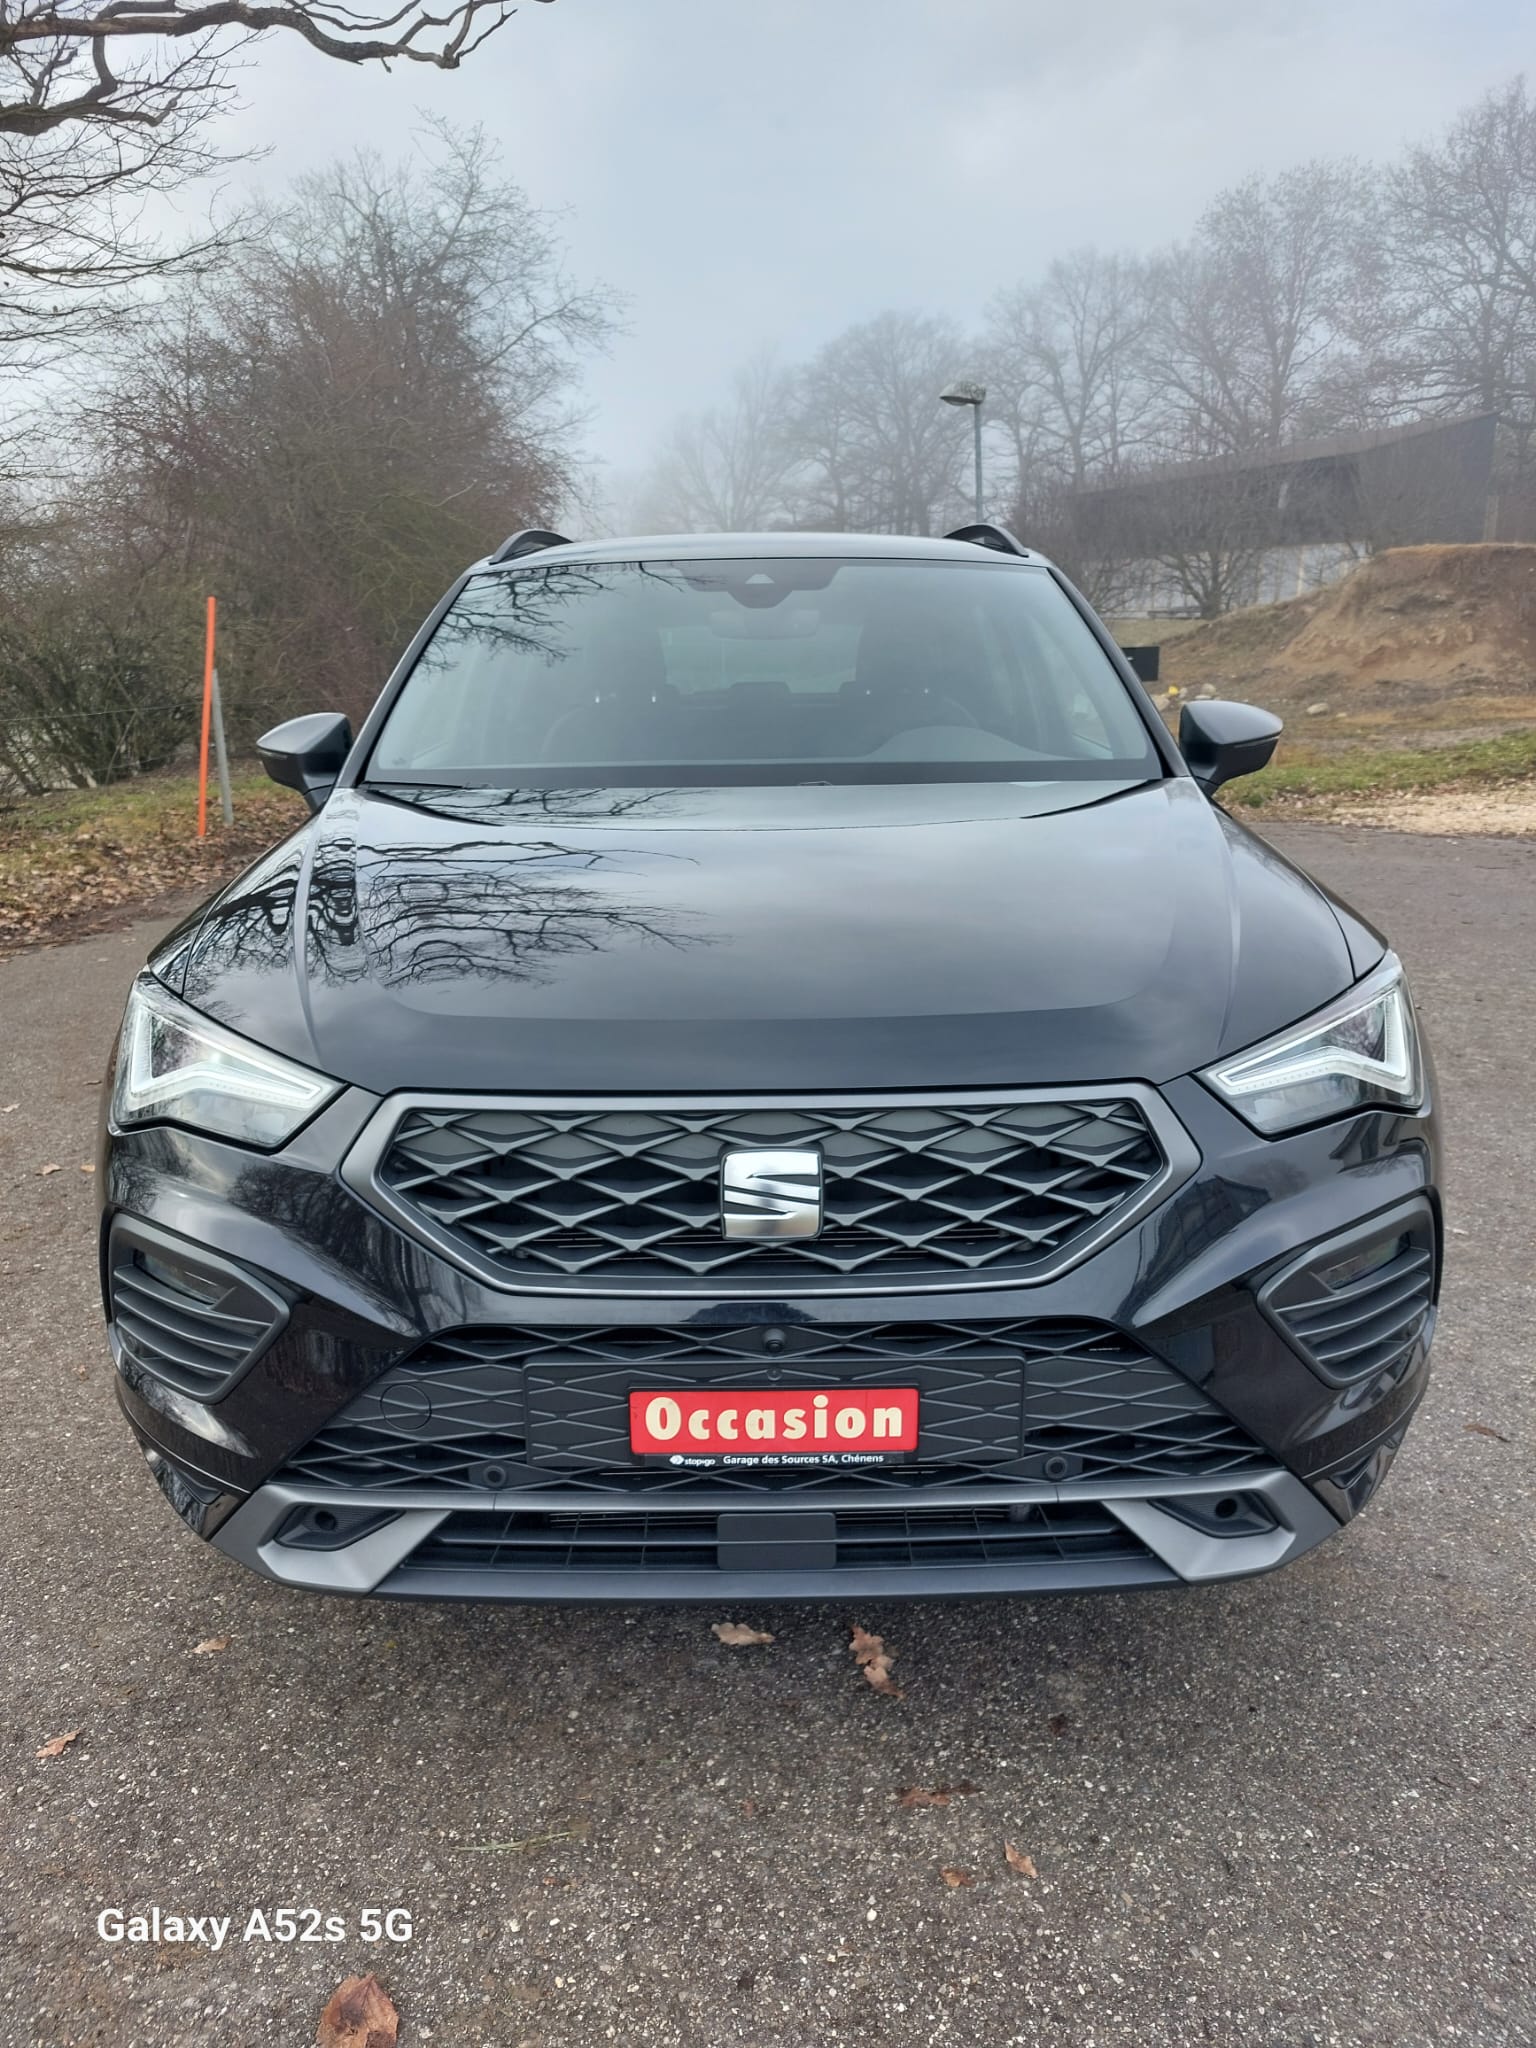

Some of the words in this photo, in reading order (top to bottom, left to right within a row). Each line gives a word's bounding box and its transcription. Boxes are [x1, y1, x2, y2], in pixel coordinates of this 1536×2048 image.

[645, 1394, 903, 1441] Occasion
[723, 1455, 760, 1466] Garage
[761, 1455, 780, 1464] des
[781, 1455, 820, 1465] Sources
[821, 1454, 839, 1464] SA,
[841, 1453, 884, 1463] Chénens
